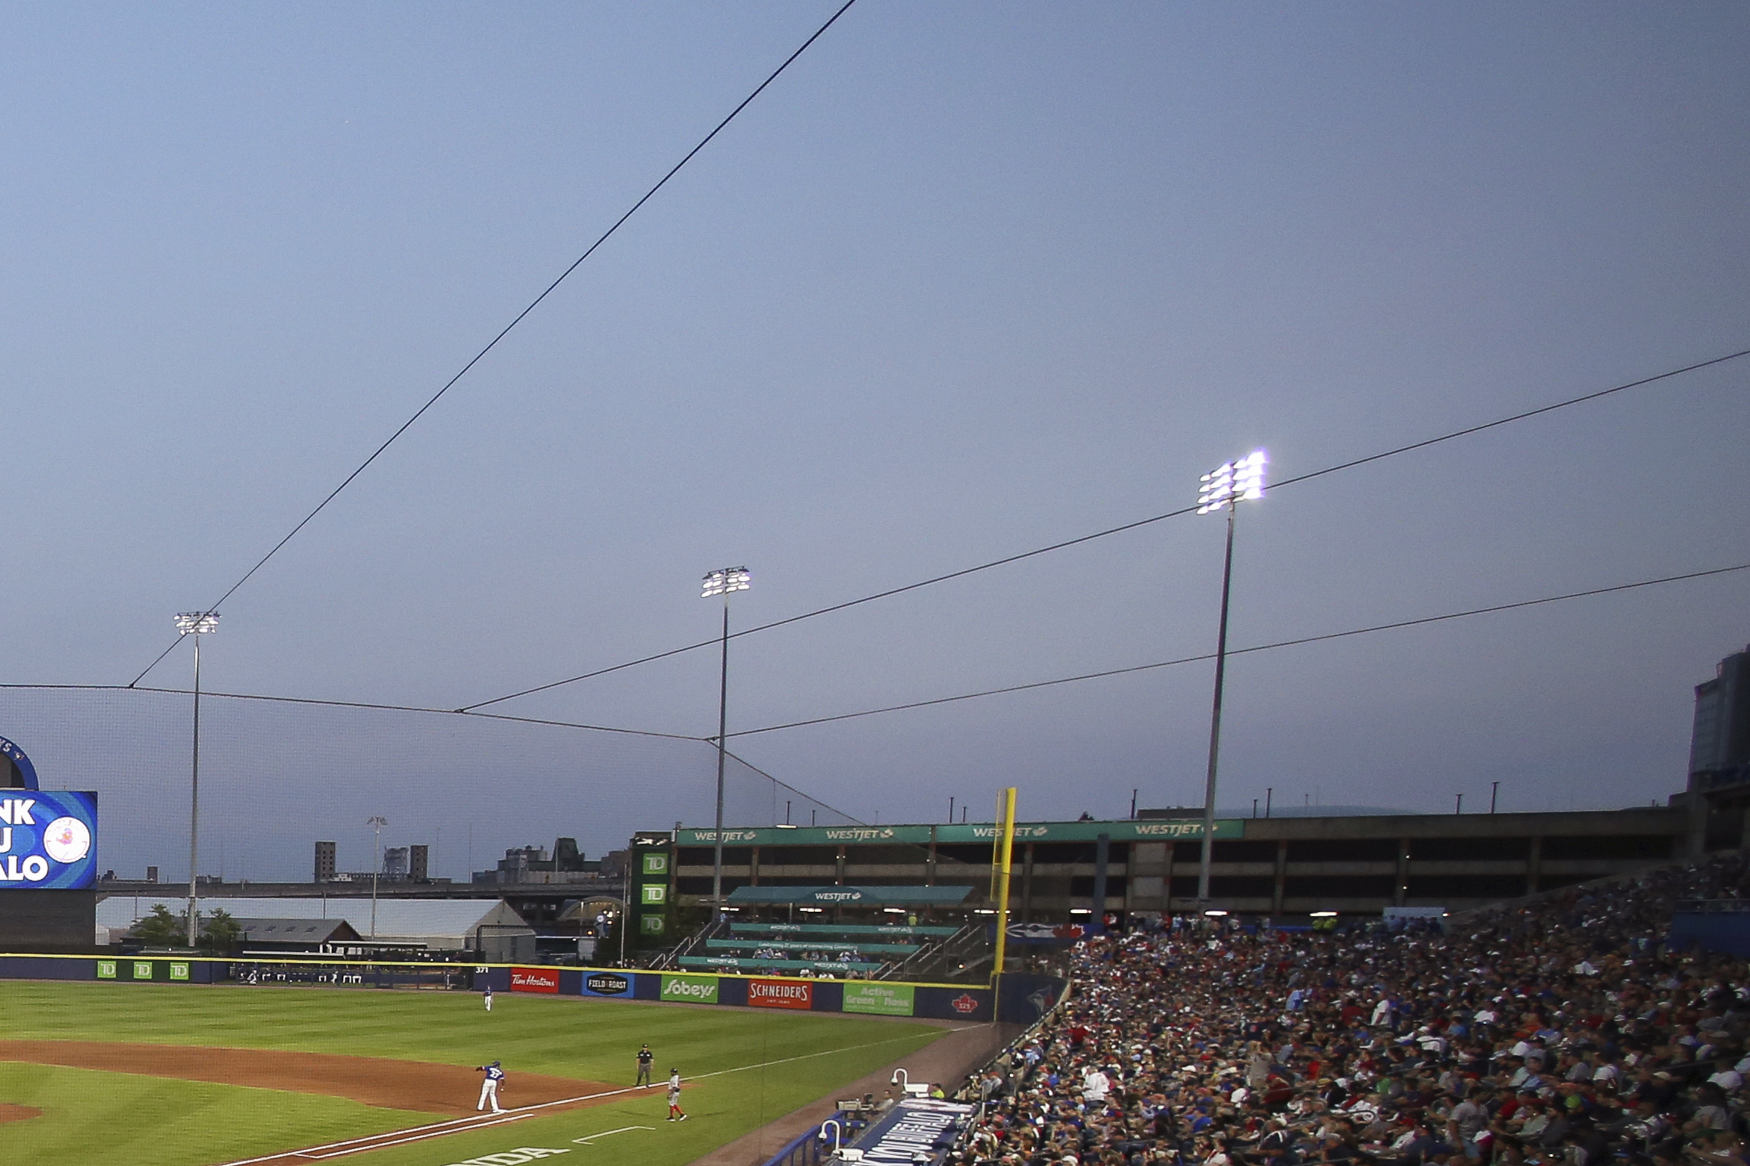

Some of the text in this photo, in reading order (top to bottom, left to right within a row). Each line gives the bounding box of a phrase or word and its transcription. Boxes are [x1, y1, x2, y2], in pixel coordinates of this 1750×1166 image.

[826, 830, 879, 842] WESTJET
[973, 827, 1033, 838] WESET
[1135, 824, 1201, 836] WESTJET
[695, 831, 744, 843] WESTJET
[646, 857, 664, 870] TD
[645, 887, 664, 900] TD
[815, 892, 852, 902] WESTJET
[100, 964, 116, 975] TD
[136, 964, 150, 976] TD
[171, 965, 186, 976] TD
[512, 974, 555, 987] Tim Hortons
[664, 978, 716, 998] Sobeys
[750, 982, 808, 1001] SCHNEIDERS
[861, 986, 895, 996] Active
